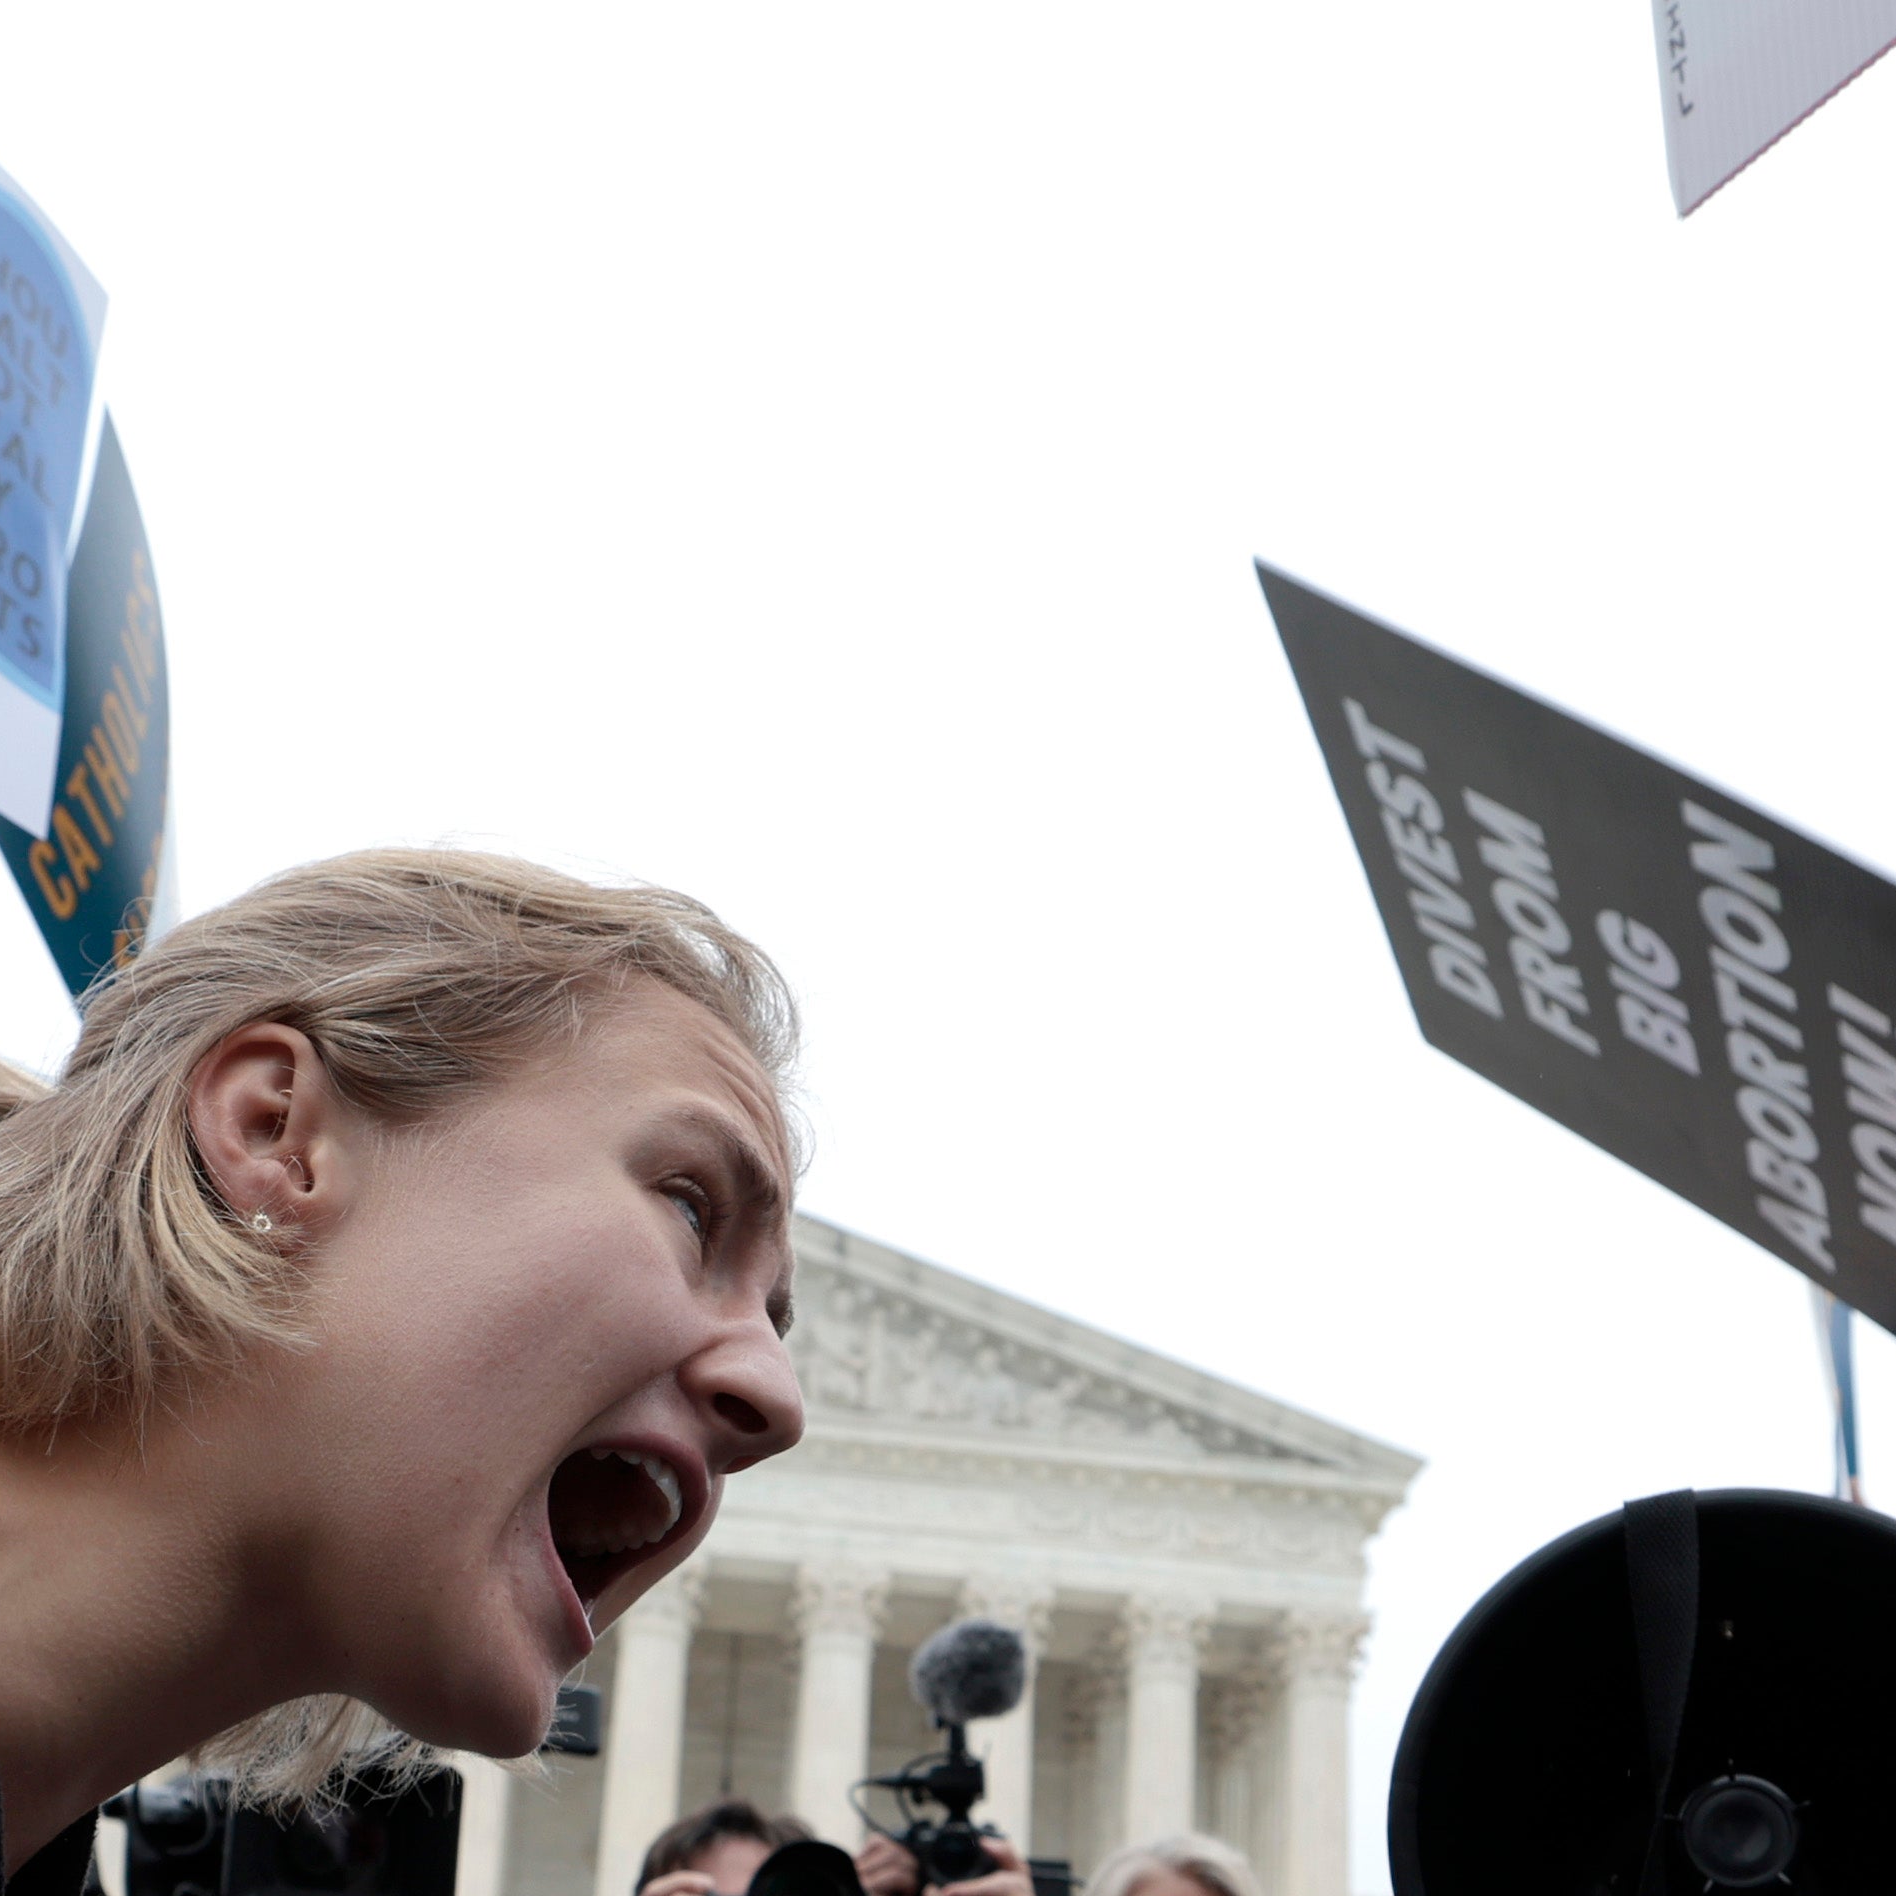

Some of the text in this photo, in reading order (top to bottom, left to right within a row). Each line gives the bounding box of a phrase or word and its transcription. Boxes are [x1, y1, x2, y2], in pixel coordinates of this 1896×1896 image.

[1341, 694, 1504, 1021] DIVEST
[1460, 785, 1602, 1058] FROM
[1595, 908, 1703, 1078] BIG
[1680, 797, 1838, 1275] ABORTION
